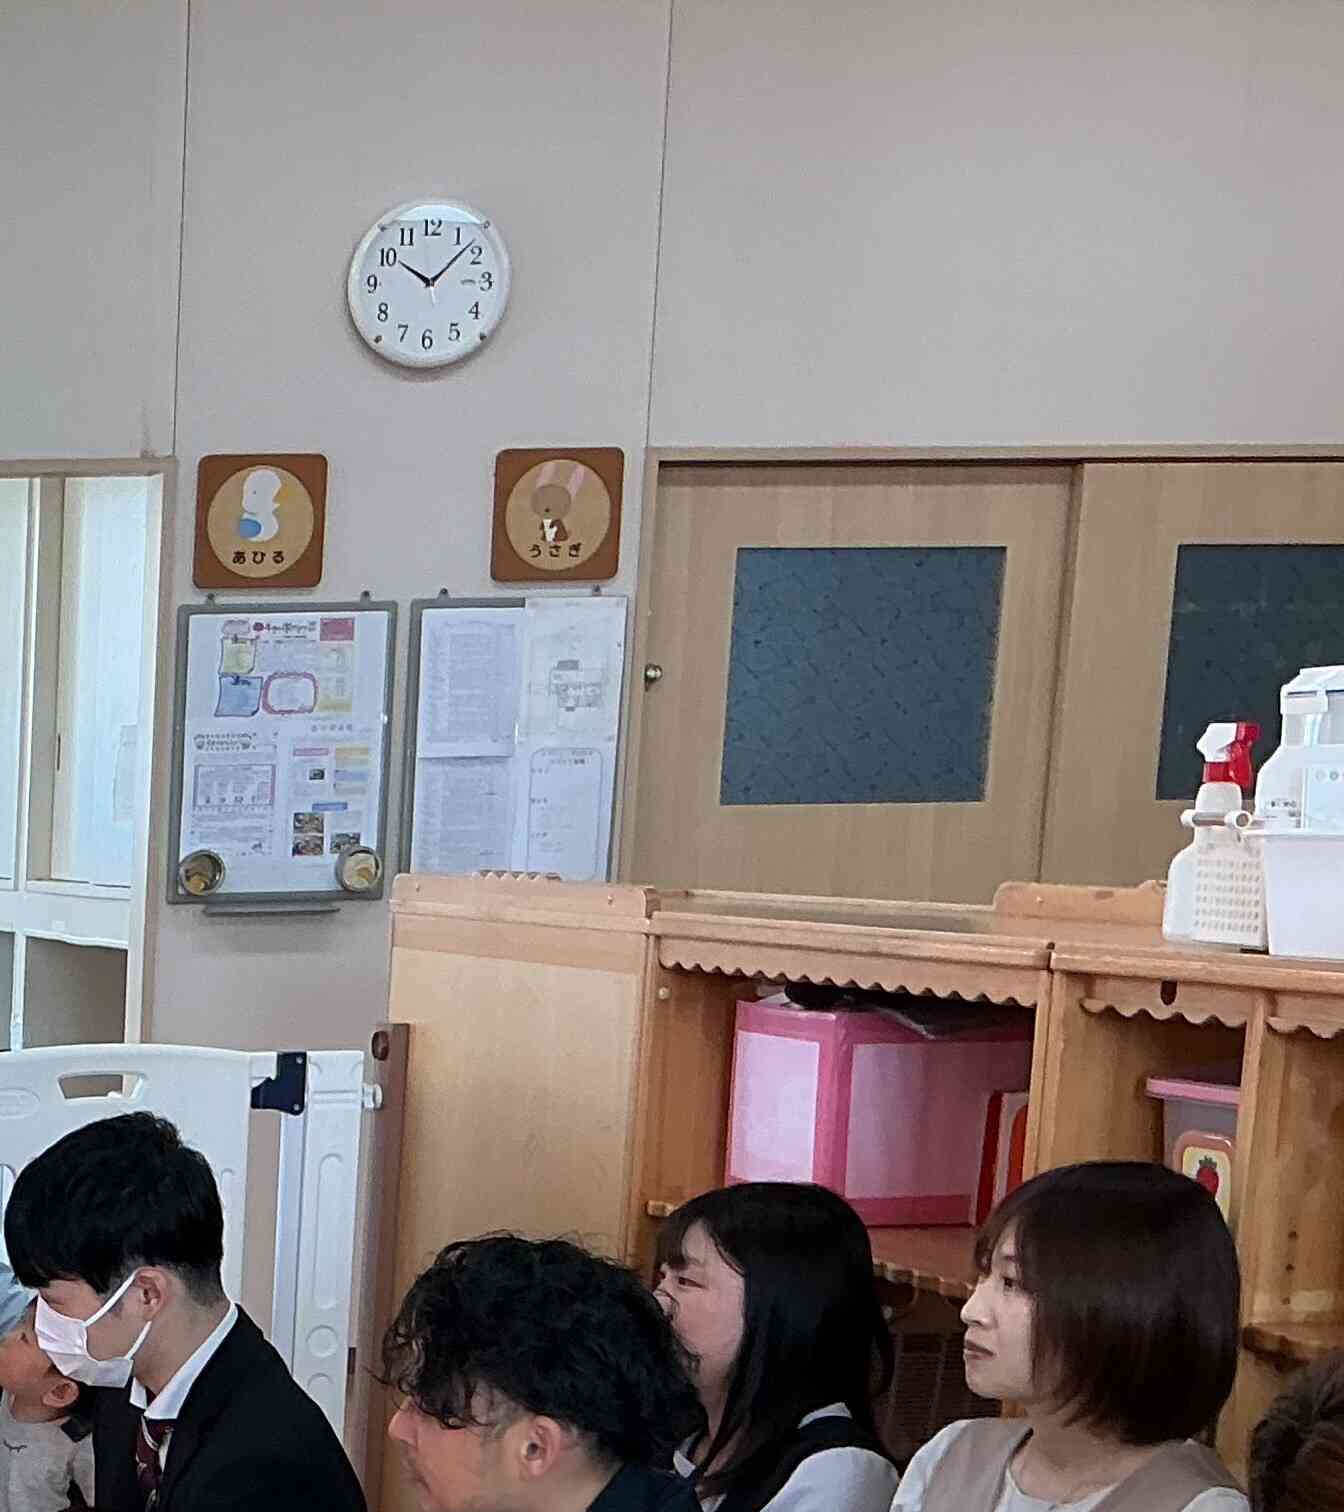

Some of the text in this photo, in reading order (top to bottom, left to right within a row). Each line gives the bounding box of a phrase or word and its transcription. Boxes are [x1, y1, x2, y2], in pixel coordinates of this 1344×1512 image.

[399, 228, 415, 246] 11
[423, 218, 443, 237] 12
[454, 227, 462, 246] 1
[379, 248, 398, 267] 10
[470, 247, 483, 265] 2
[367, 274, 378, 294] 9
[479, 272, 494, 292] 3
[377, 302, 389, 322] 8
[468, 302, 481, 320] 4
[397, 324, 409, 343] 7
[421, 330, 433, 350] 6
[448, 323, 461, 342] 5
[232, 550, 285, 565] あひる
[529, 541, 582, 558] うさぎ
